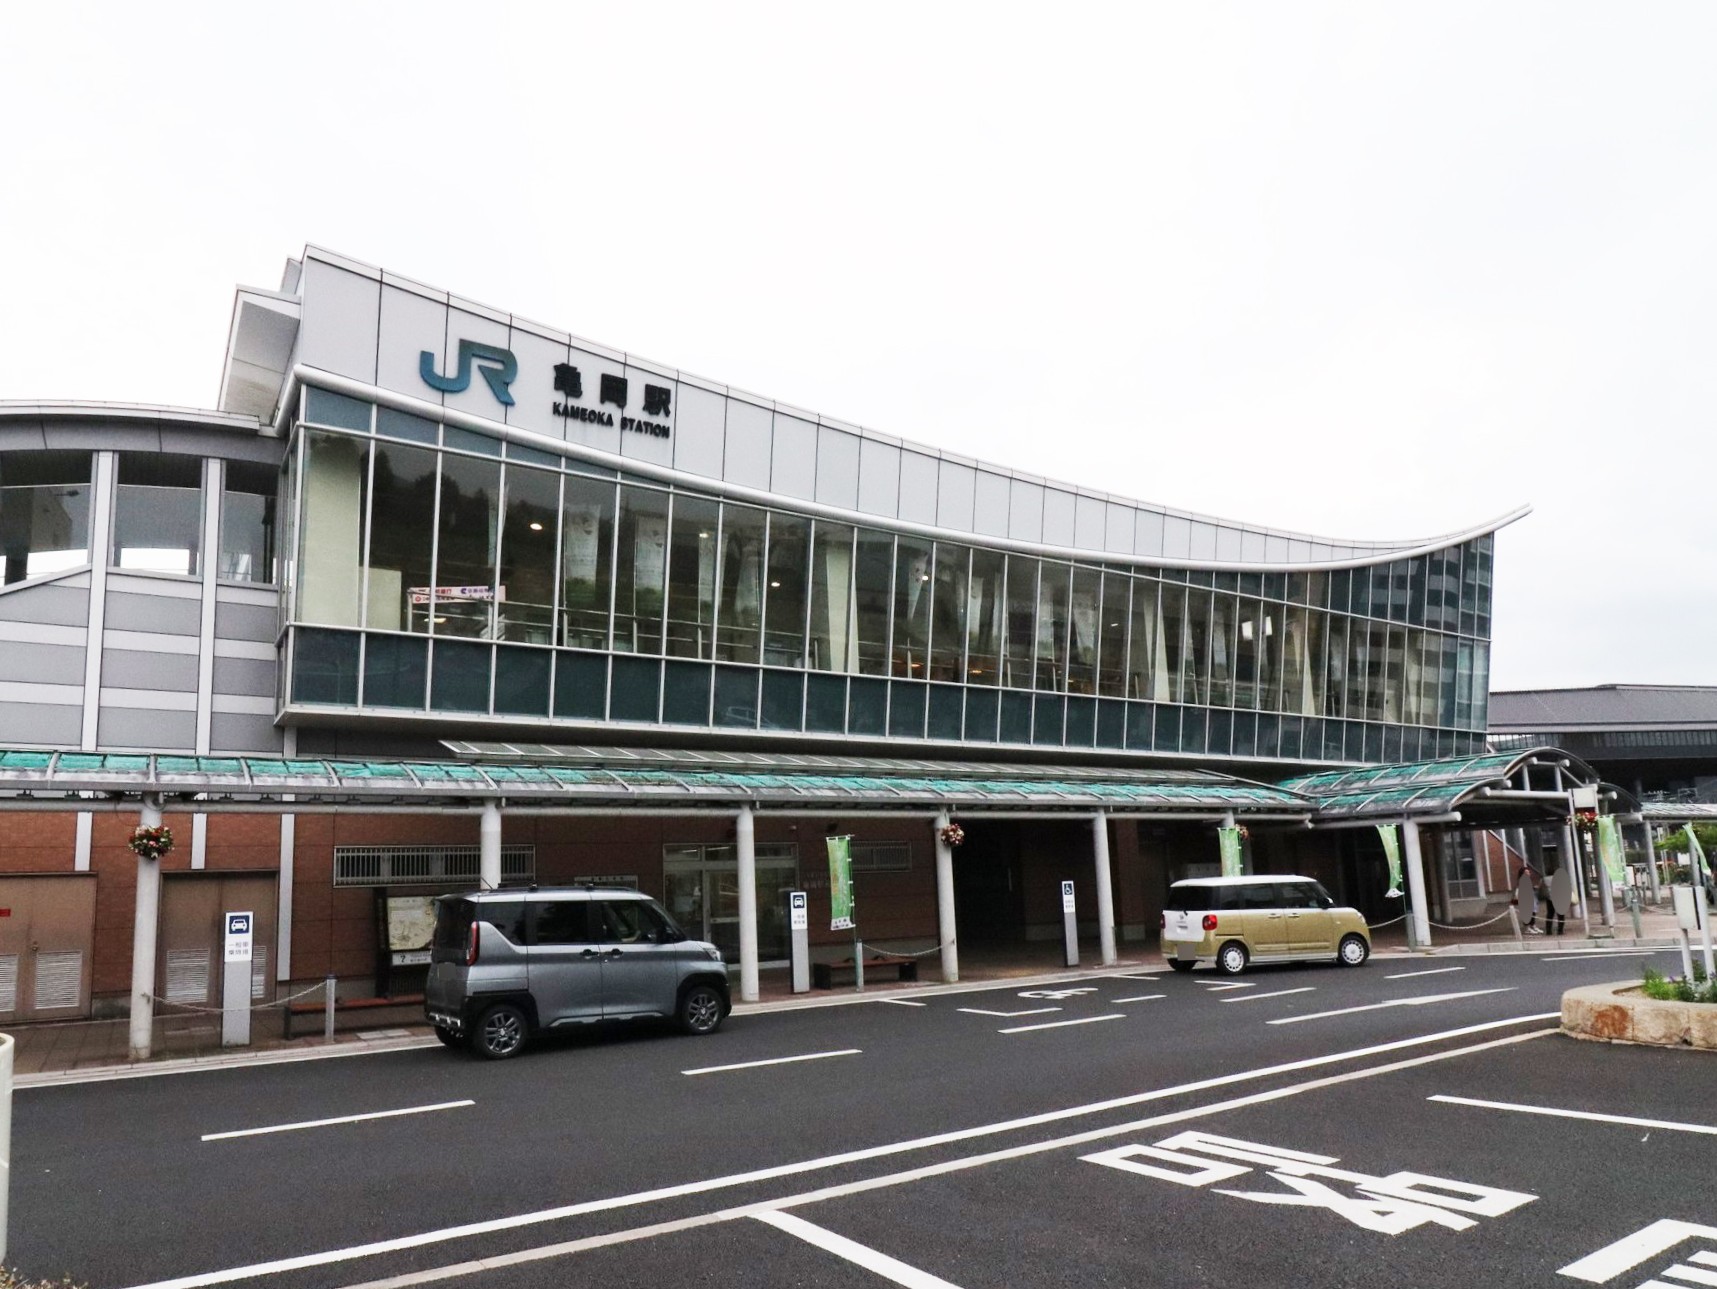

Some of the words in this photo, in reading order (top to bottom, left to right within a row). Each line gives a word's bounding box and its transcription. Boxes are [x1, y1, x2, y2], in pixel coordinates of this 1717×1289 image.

[420, 339, 518, 406] JR
[553, 363, 671, 417] 亀岡駅
[553, 402, 613, 427] KAMEOKA
[620, 417, 670, 438] STATION
